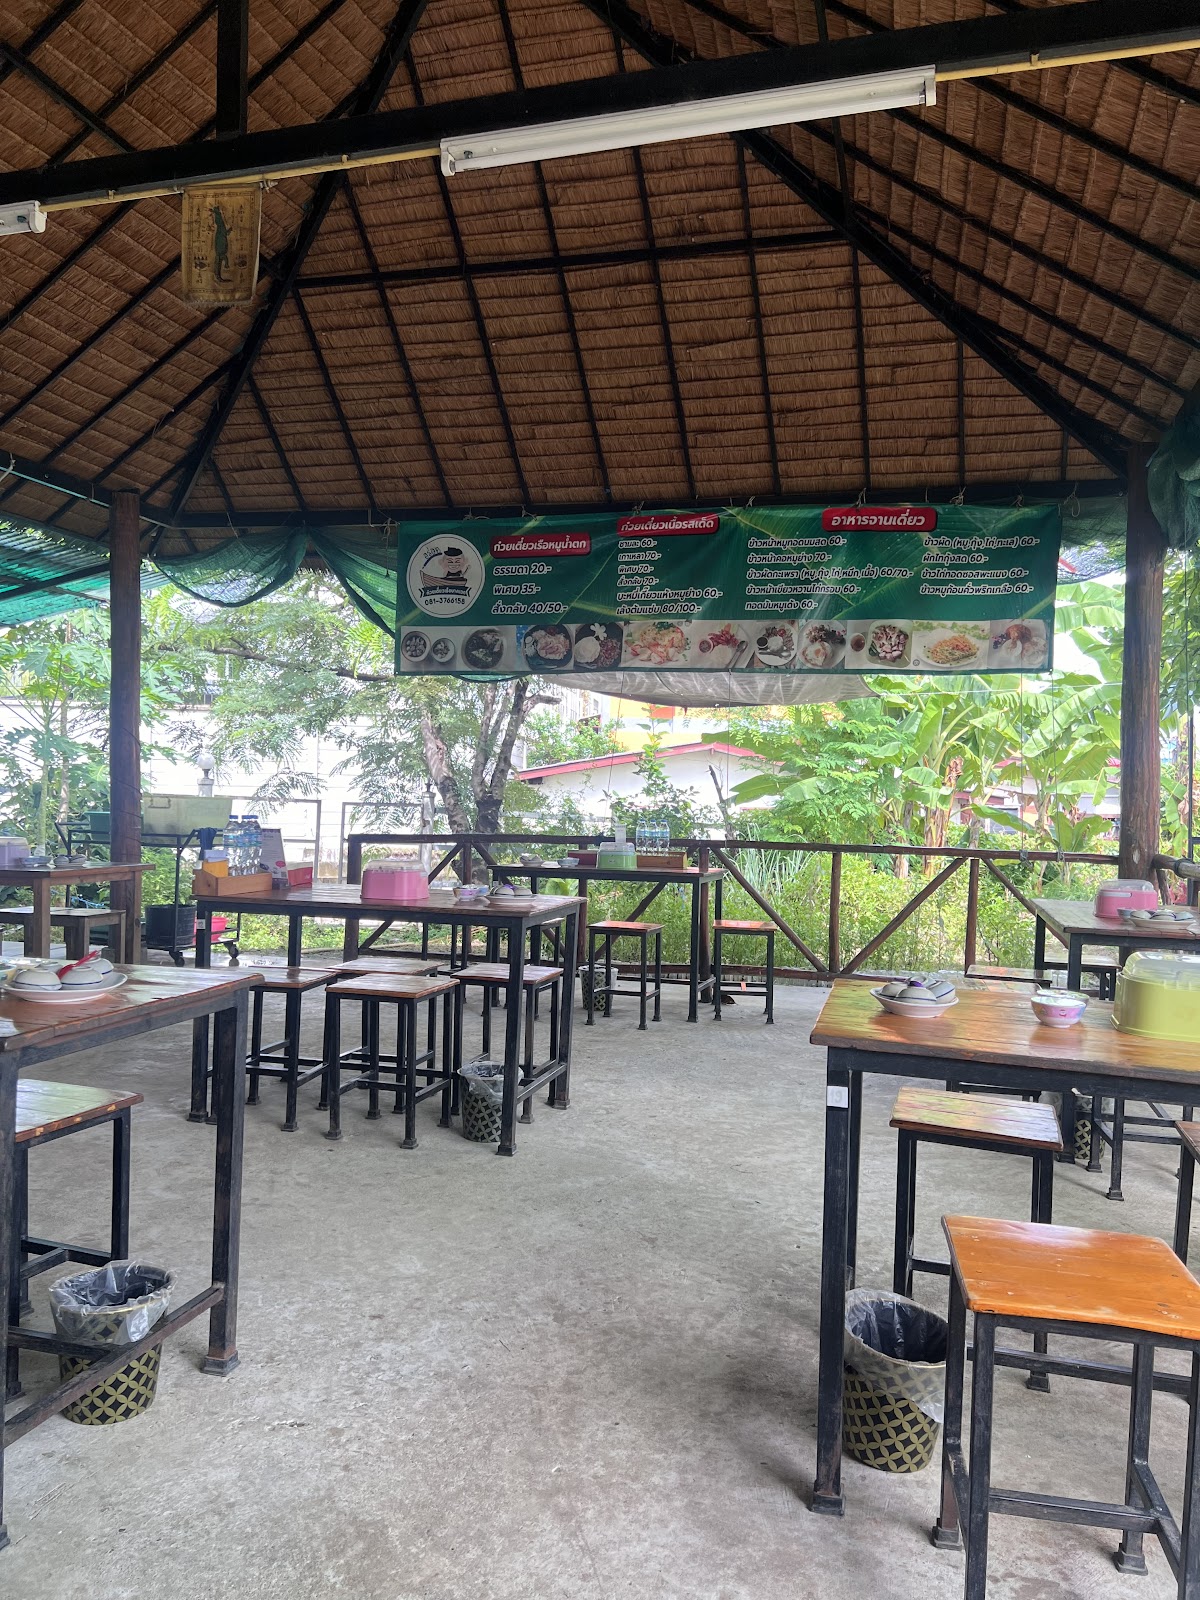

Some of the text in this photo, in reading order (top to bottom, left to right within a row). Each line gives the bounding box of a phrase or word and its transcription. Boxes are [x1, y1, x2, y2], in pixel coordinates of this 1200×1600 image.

[831, 508, 925, 526] อาหารจานเดี่ยว
[621, 516, 715, 531] ก๋วยเตี๋ยวเนื้อรสเด็ด
[493, 535, 587, 552] ก๋วยเตี๋ยวเรือหมูน้ำตก
[618, 539, 640, 548] ชามละ
[923, 536, 952, 547] ข้าวผัด
[618, 552, 645, 561] เกาเหลา
[747, 552, 814, 566] ข้าวหน้าคอหมูย่าง
[493, 565, 528, 576] ธรรมดา
[747, 568, 800, 580] ข้าวผัดกะเพรา
[617, 575, 642, 587] สั่งกลับ
[493, 583, 519, 595] พิเศษ
[491, 600, 526, 615] สั่งกลับ
